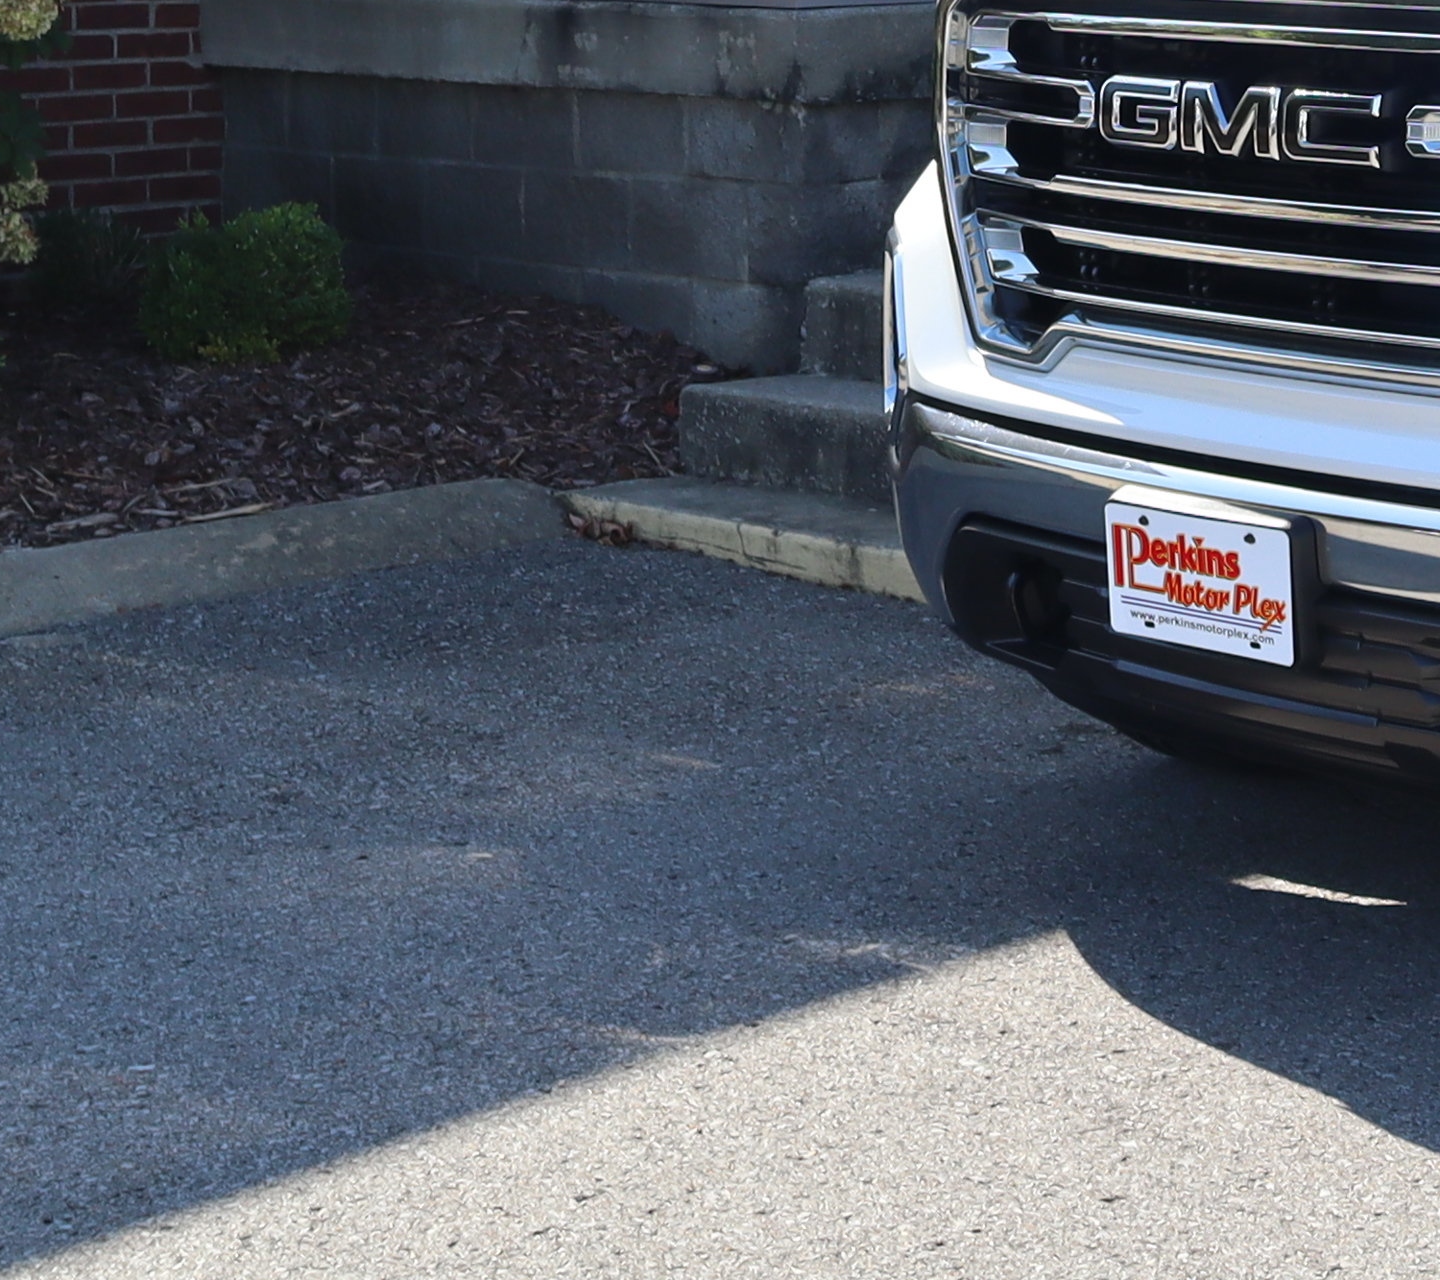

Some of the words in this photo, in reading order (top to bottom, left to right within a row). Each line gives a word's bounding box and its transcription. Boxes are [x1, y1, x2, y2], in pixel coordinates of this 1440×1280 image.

[1099, 75, 1382, 168] GMC
[1112, 523, 1241, 594] Perkins
[1130, 609, 1275, 646] www.perkinsmotorplex.com
[1163, 571, 1230, 613] Motor
[1232, 583, 1286, 632] Plex
